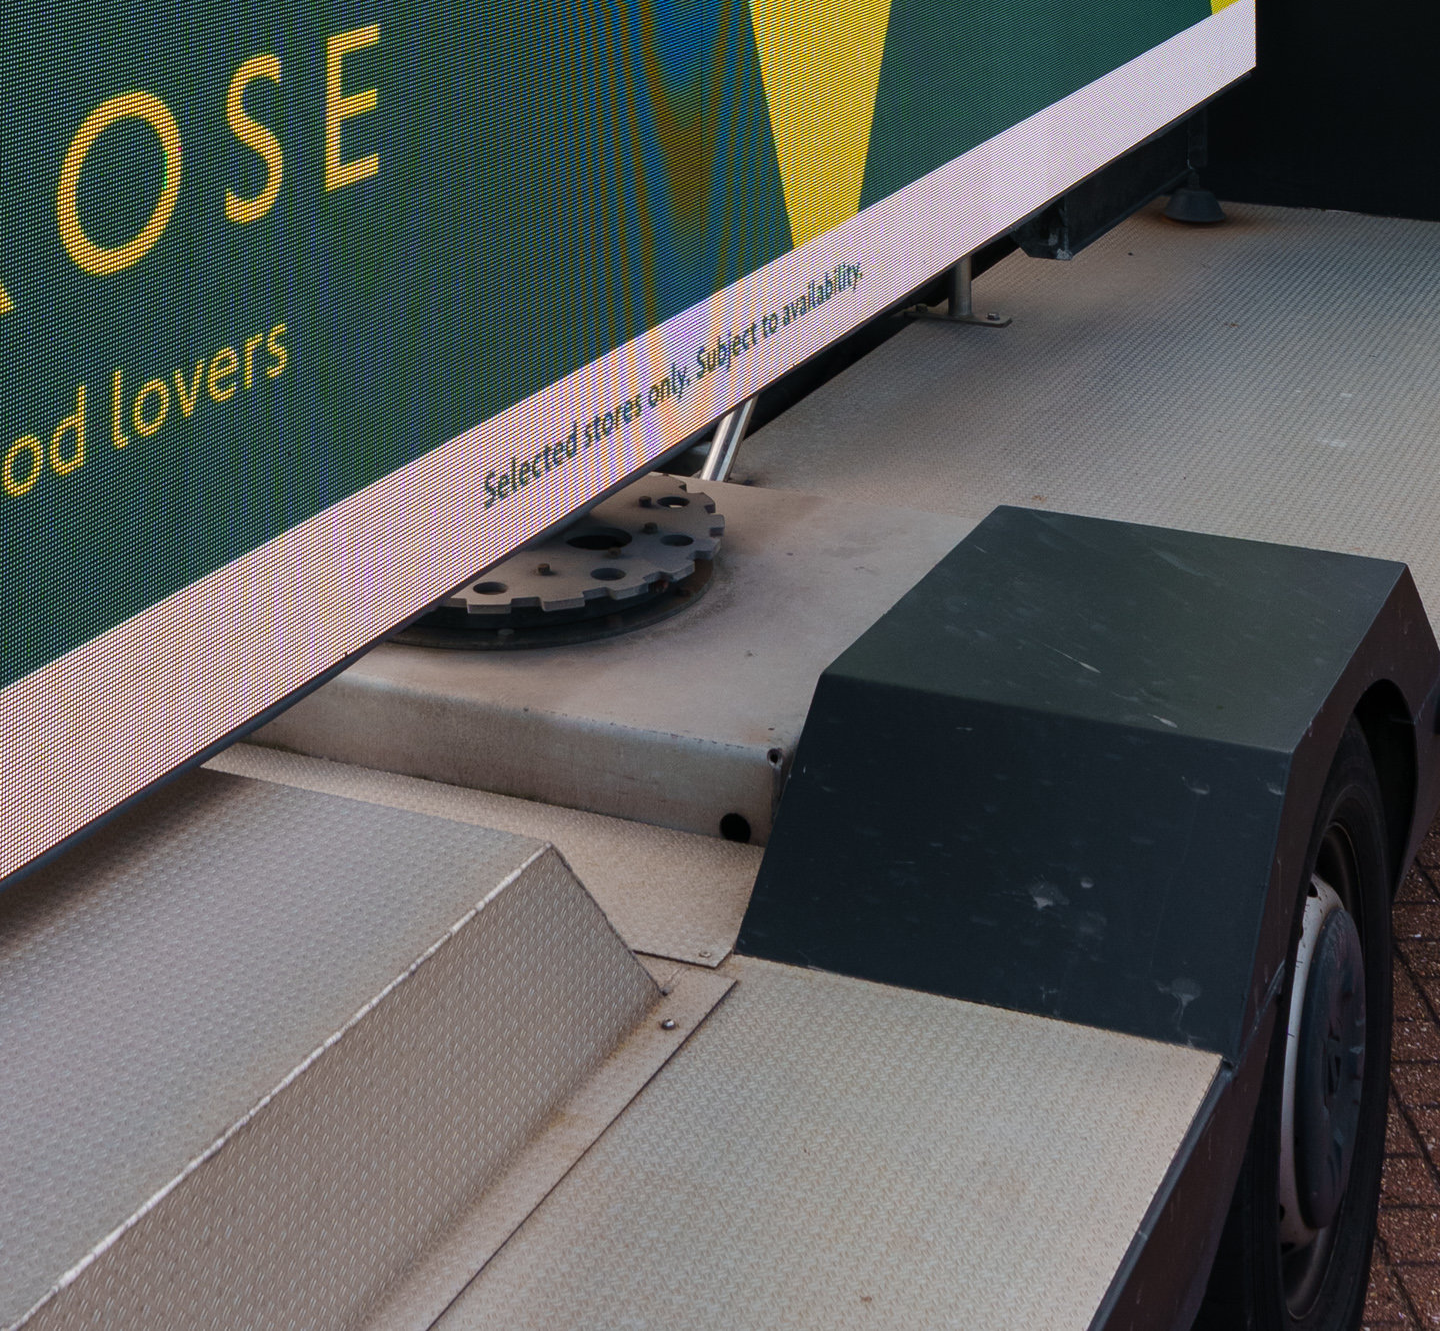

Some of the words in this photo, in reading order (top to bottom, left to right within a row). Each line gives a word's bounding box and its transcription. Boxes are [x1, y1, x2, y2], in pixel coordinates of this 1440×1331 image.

[112, 322, 289, 454] lovers
[484, 422, 578, 508] Selected
[582, 399, 643, 449] stores
[647, 363, 691, 407] only.
[696, 322, 758, 379] Subject
[762, 313, 779, 338] to
[782, 261, 863, 327] availability.
